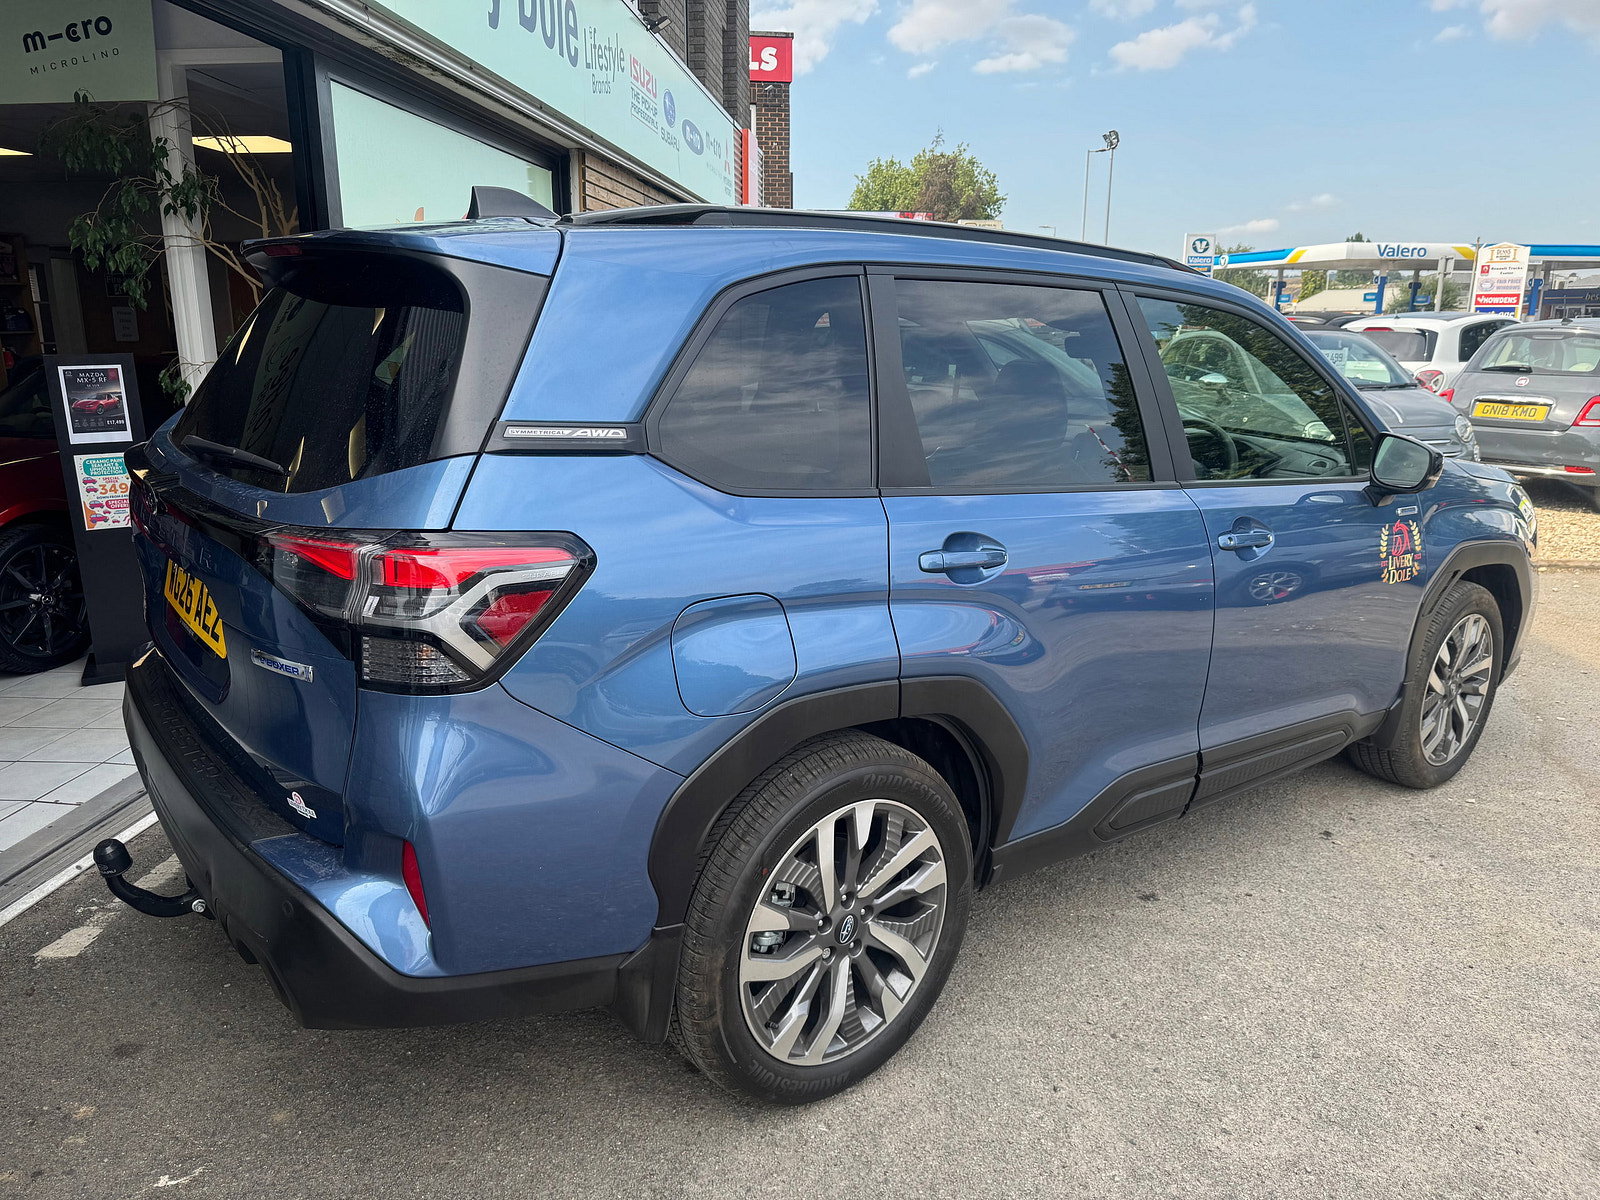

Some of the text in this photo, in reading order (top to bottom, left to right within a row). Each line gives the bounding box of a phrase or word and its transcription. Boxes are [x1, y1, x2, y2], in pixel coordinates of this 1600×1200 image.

[30, 47, 120, 74] MICROLINO
[583, 26, 625, 82] Lifestyle
[591, 73, 611, 94] Brands
[629, 53, 657, 99] ISUZU
[630, 86, 641, 105] THE
[660, 126, 680, 153] SUBARU
[1188, 256, 1211, 264] Valero
[1377, 244, 1427, 258] Valero
[1483, 296, 1518, 304] HOWDENS
[1482, 404, 1510, 416] GN18
[510, 428, 625, 438] SYMMETRICAL AWD
[98, 482, 129, 495] 349
[1388, 553, 1414, 571] LIVERY
[1389, 568, 1412, 585] DOLE
[862, 773, 954, 820] BRIDGESTONE
